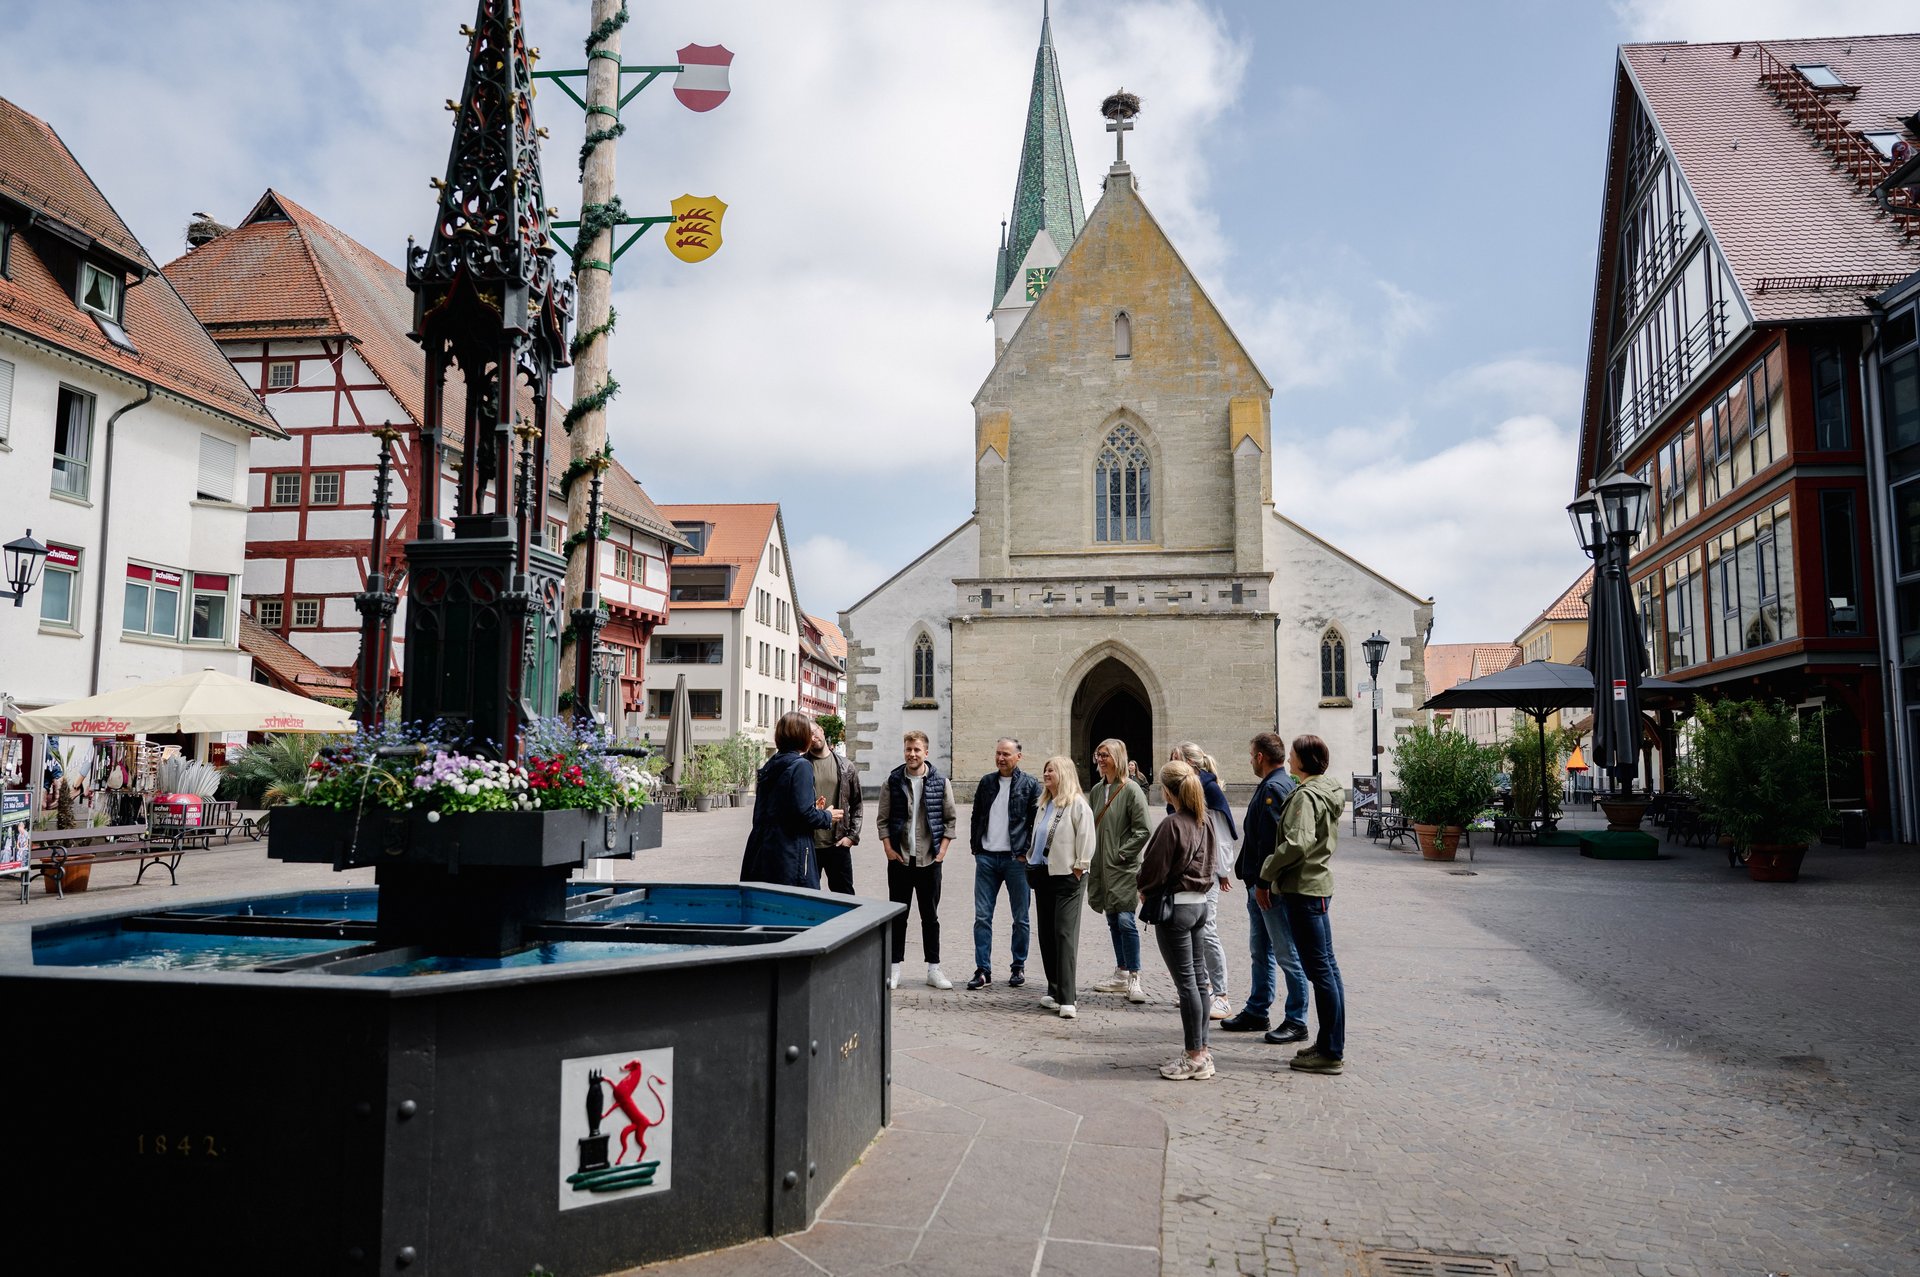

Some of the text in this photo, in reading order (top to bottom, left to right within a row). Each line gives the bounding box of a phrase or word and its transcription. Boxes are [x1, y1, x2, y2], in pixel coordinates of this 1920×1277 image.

[71, 717, 131, 732] schweizer
[264, 714, 304, 728] schweizer
[138, 1133, 219, 1157] 1842
